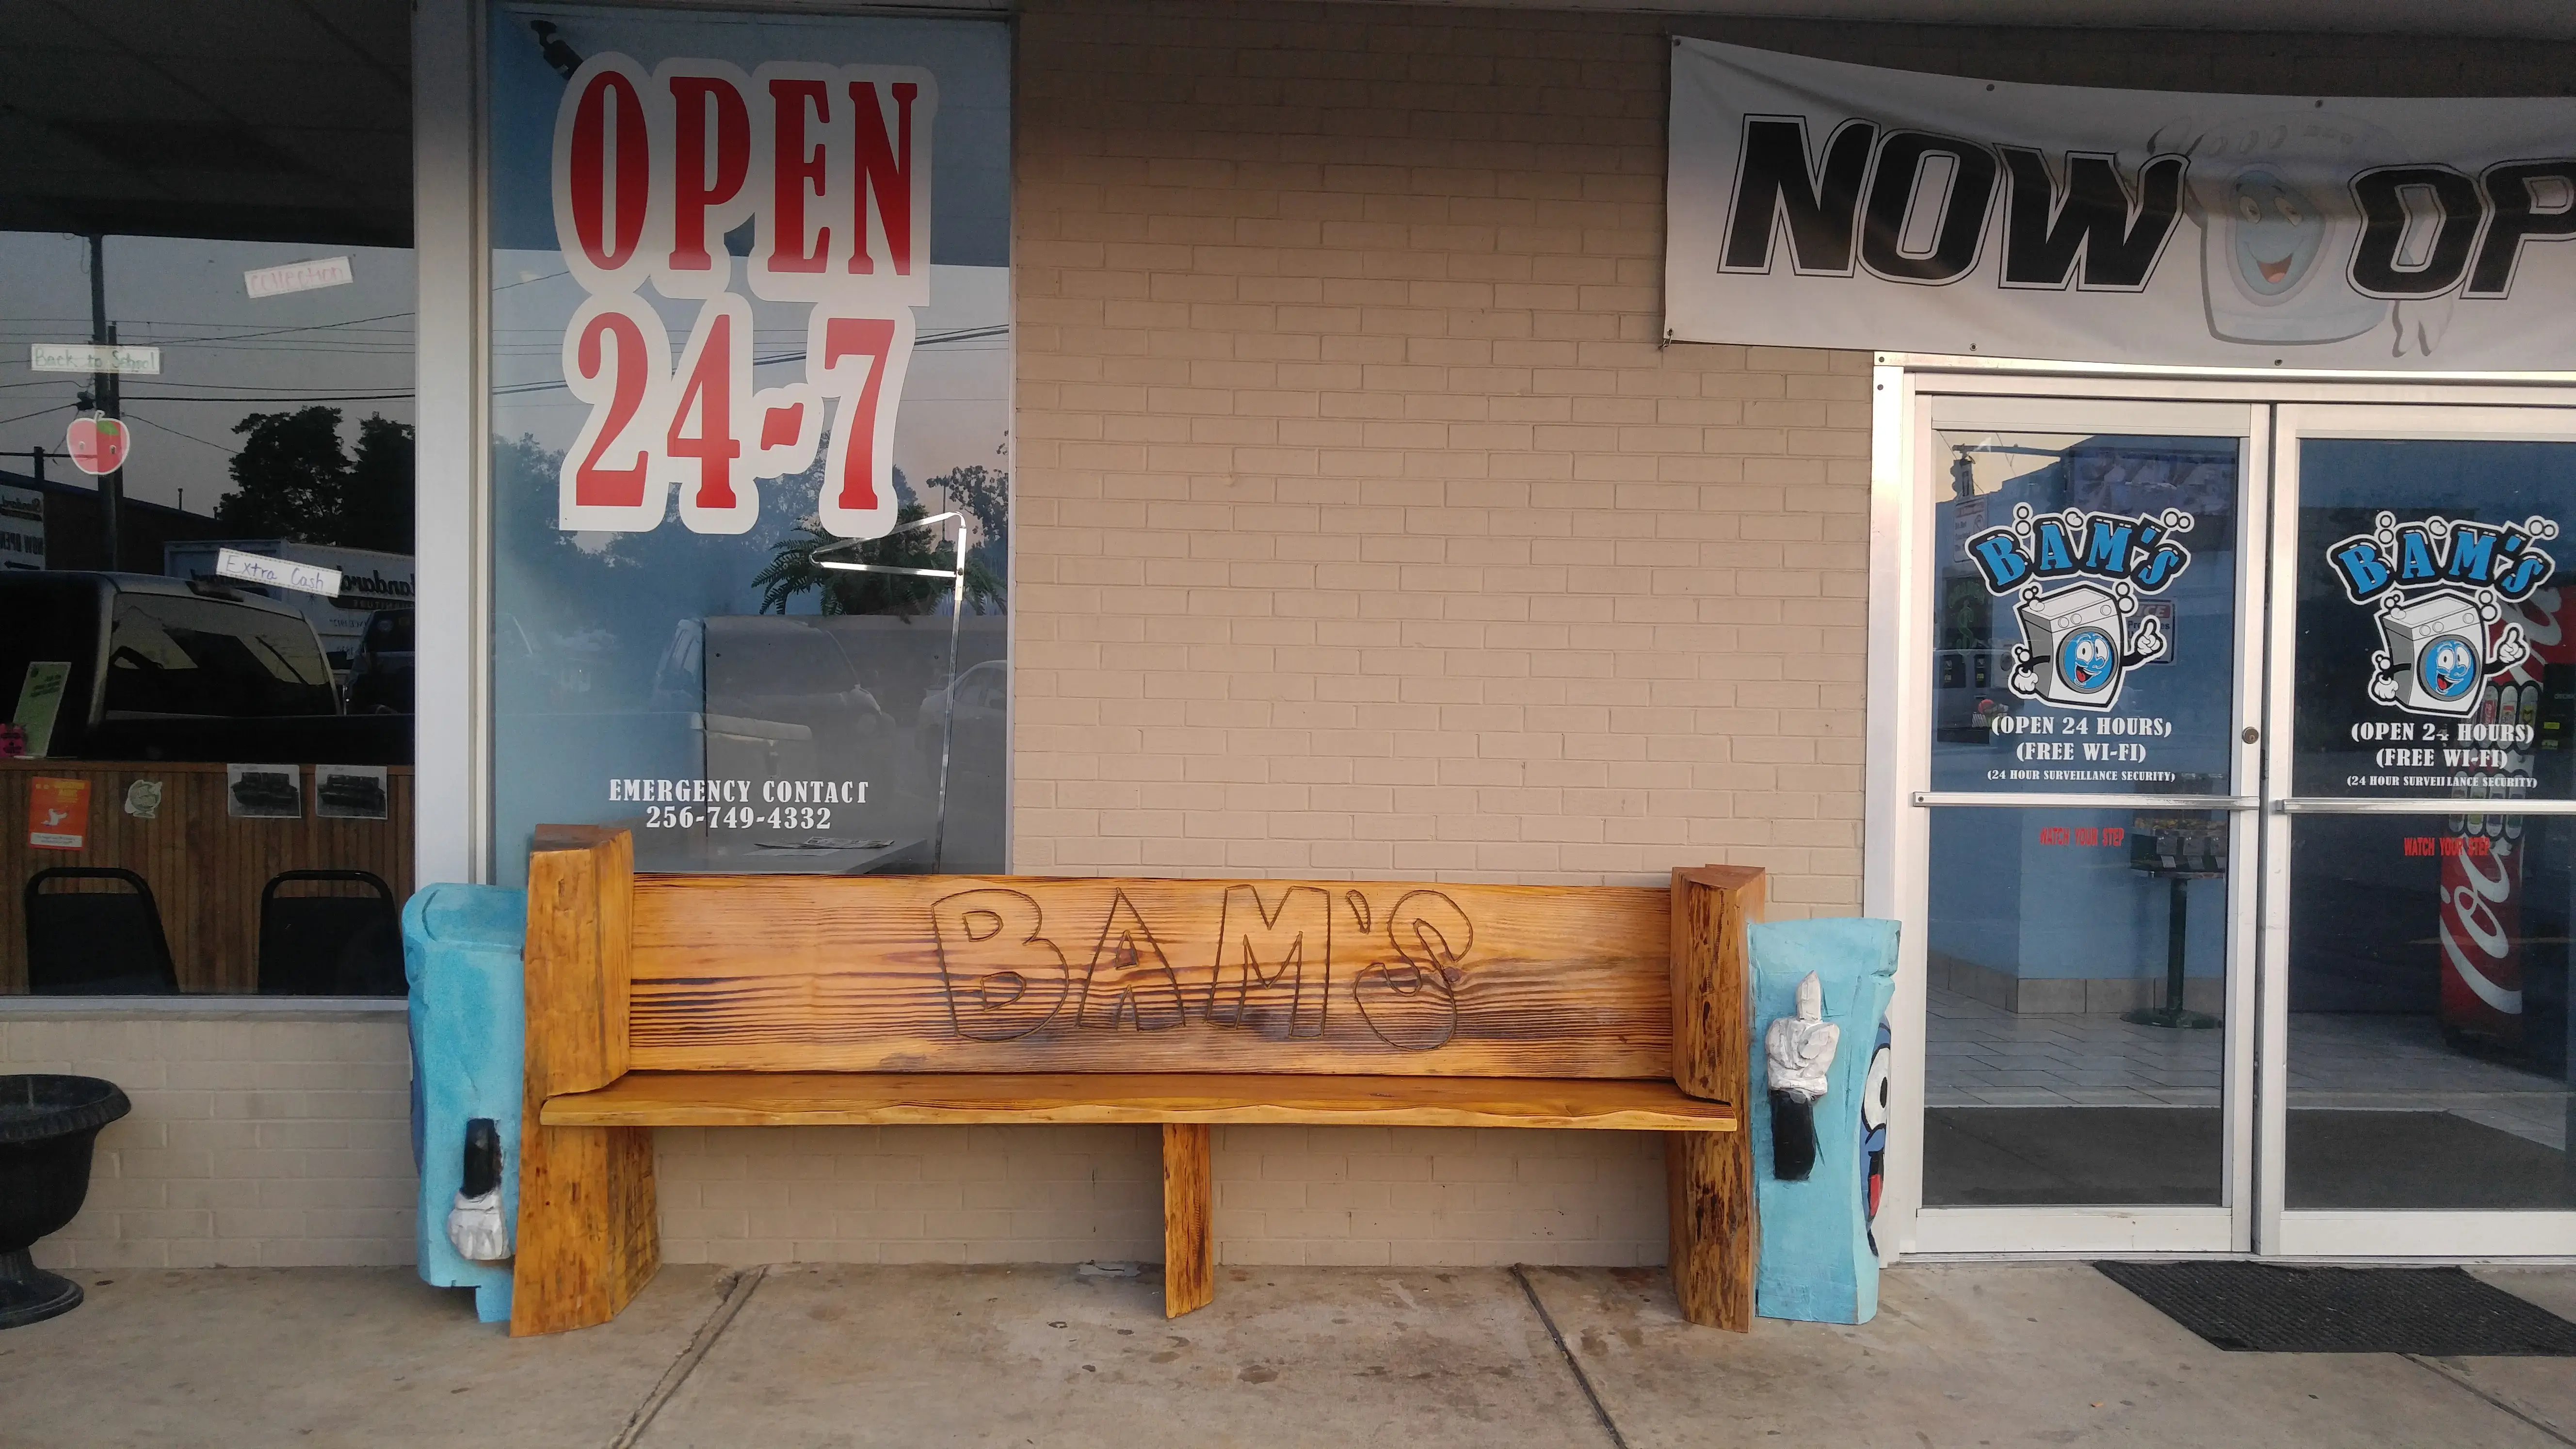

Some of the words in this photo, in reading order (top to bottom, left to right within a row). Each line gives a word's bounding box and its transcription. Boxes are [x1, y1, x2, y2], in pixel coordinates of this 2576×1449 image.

[570, 71, 918, 276] OPEN
[1718, 112, 2190, 292] NOW
[2346, 157, 2576, 300] OP
[87, 354, 103, 368] to
[576, 312, 896, 509] 24-7
[1972, 515, 2185, 592] BAM'S
[2334, 527, 2548, 598] BAM'S
[226, 554, 277, 580] Extra
[291, 567, 323, 590] Cash
[1991, 715, 2054, 737] (OPEN
[2062, 717, 2088, 735] 24
[2097, 717, 2172, 738] HOURS)
[2351, 722, 2415, 742] (OPEN
[2457, 723, 2534, 744] HOURS)
[2016, 742, 2074, 762] (FREE
[2082, 742, 2146, 763] WI-FI)
[2376, 748, 2434, 769] (FREE
[2443, 749, 2508, 770] WI-FI)
[1987, 769, 2006, 782] (24
[2010, 770, 2040, 780] HOUR
[2043, 770, 2118, 782] SURVEILLANCE
[2121, 771, 2175, 783] SECURITY)
[2347, 775, 2366, 788] (24
[2369, 776, 2399, 786] HOUR
[2482, 777, 2538, 789] SECURITY)
[609, 779, 750, 802] EMERGENCY
[762, 780, 869, 805] CONTACT
[645, 806, 832, 830] 256-749-4332
[2040, 826, 2070, 846] WATCH
[2074, 826, 2098, 846] YOUR
[2102, 826, 2125, 847] STEP
[2403, 837, 2435, 856] WATCH
[2439, 837, 2464, 856] YOUR
[2467, 837, 2491, 856] STEP
[931, 884, 1474, 1053] BAM'S
